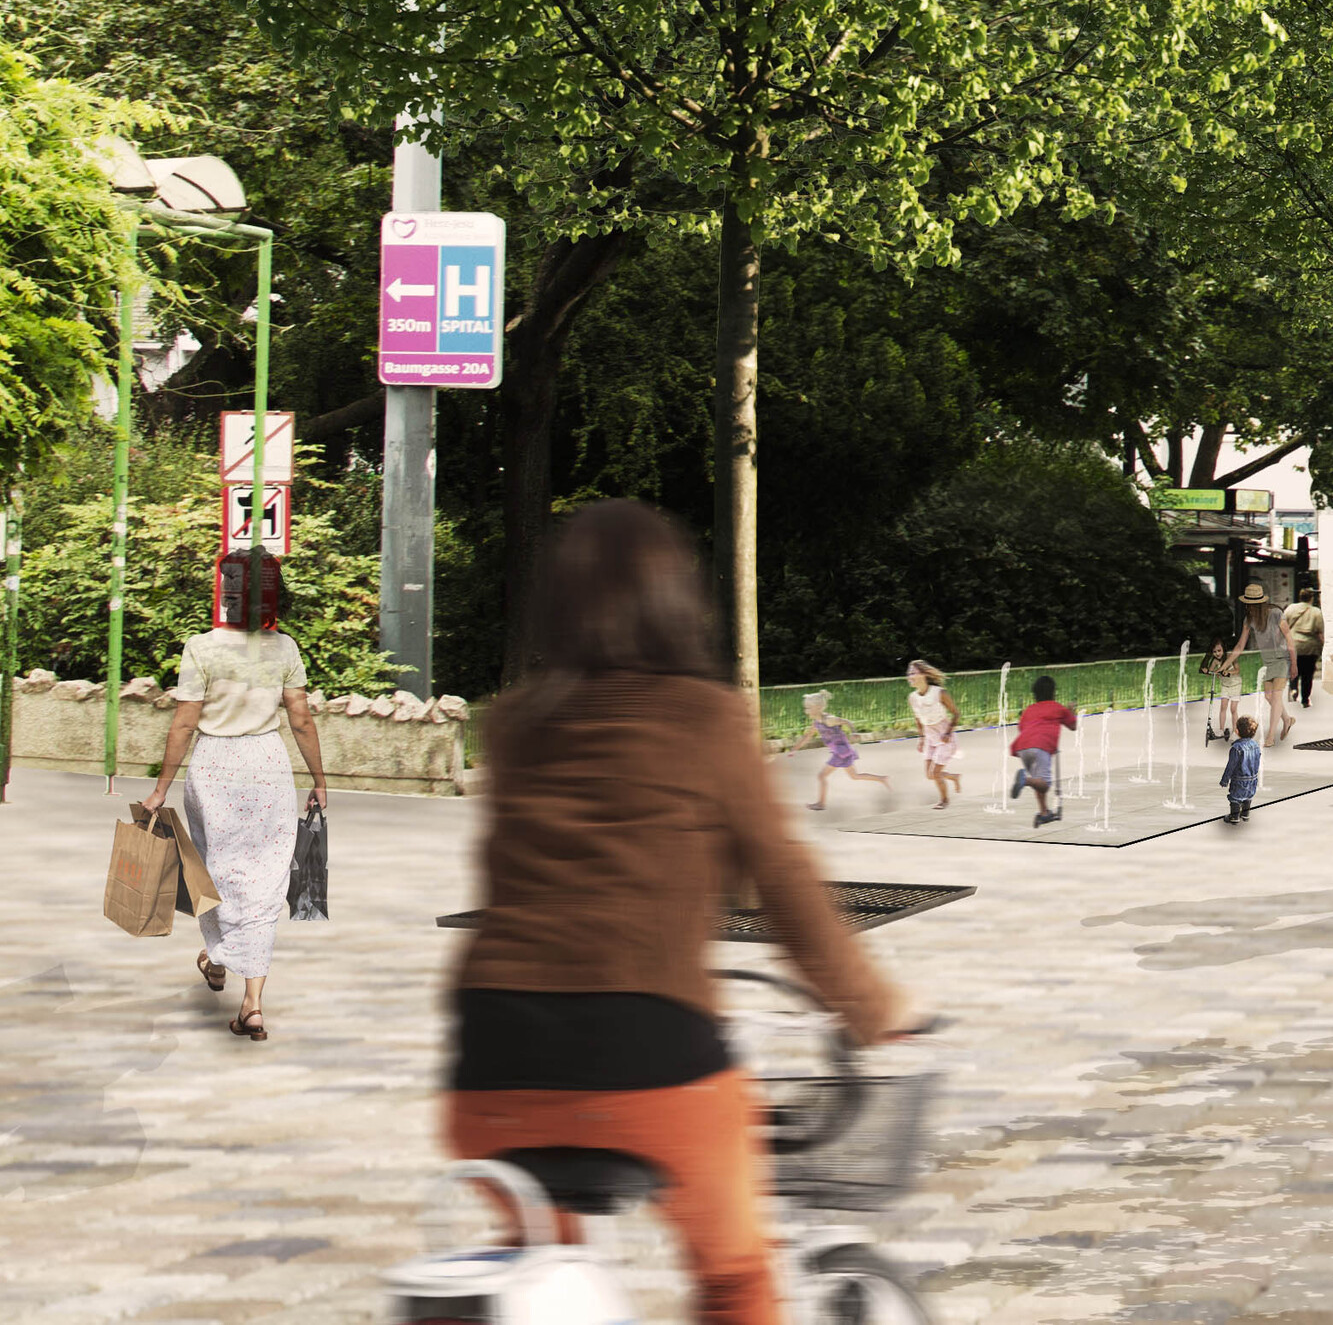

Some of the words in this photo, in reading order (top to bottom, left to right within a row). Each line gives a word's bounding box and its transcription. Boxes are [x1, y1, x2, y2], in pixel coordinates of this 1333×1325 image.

[445, 265, 490, 317] H
[387, 319, 432, 333] 350m
[441, 320, 494, 334] SPITAL
[384, 361, 460, 377] Baumgasse
[462, 362, 490, 375] 20A
